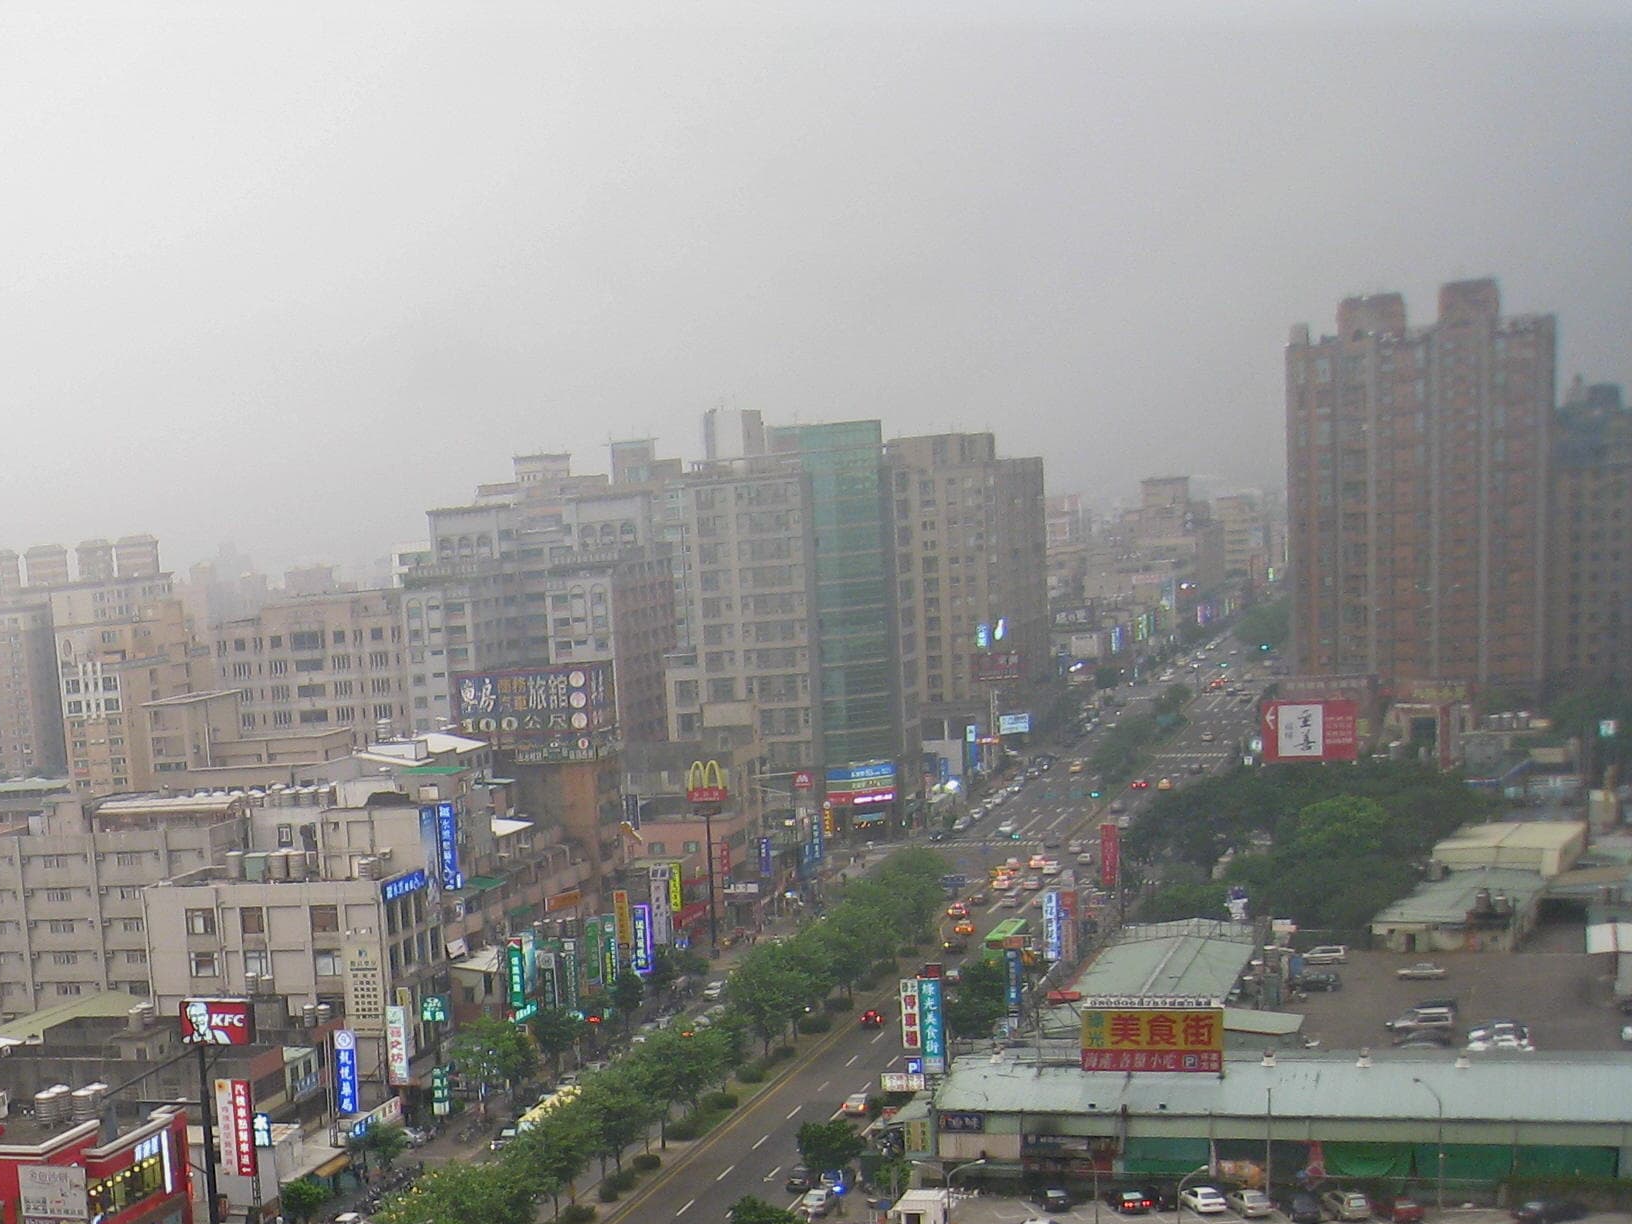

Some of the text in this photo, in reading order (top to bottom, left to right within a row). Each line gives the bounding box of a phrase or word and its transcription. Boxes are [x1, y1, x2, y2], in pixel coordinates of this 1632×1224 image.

[460, 717, 518, 734] 100
[211, 1014, 246, 1028] KFC
[1111, 1014, 1215, 1047] 美食街
[908, 1062, 919, 1074] P
